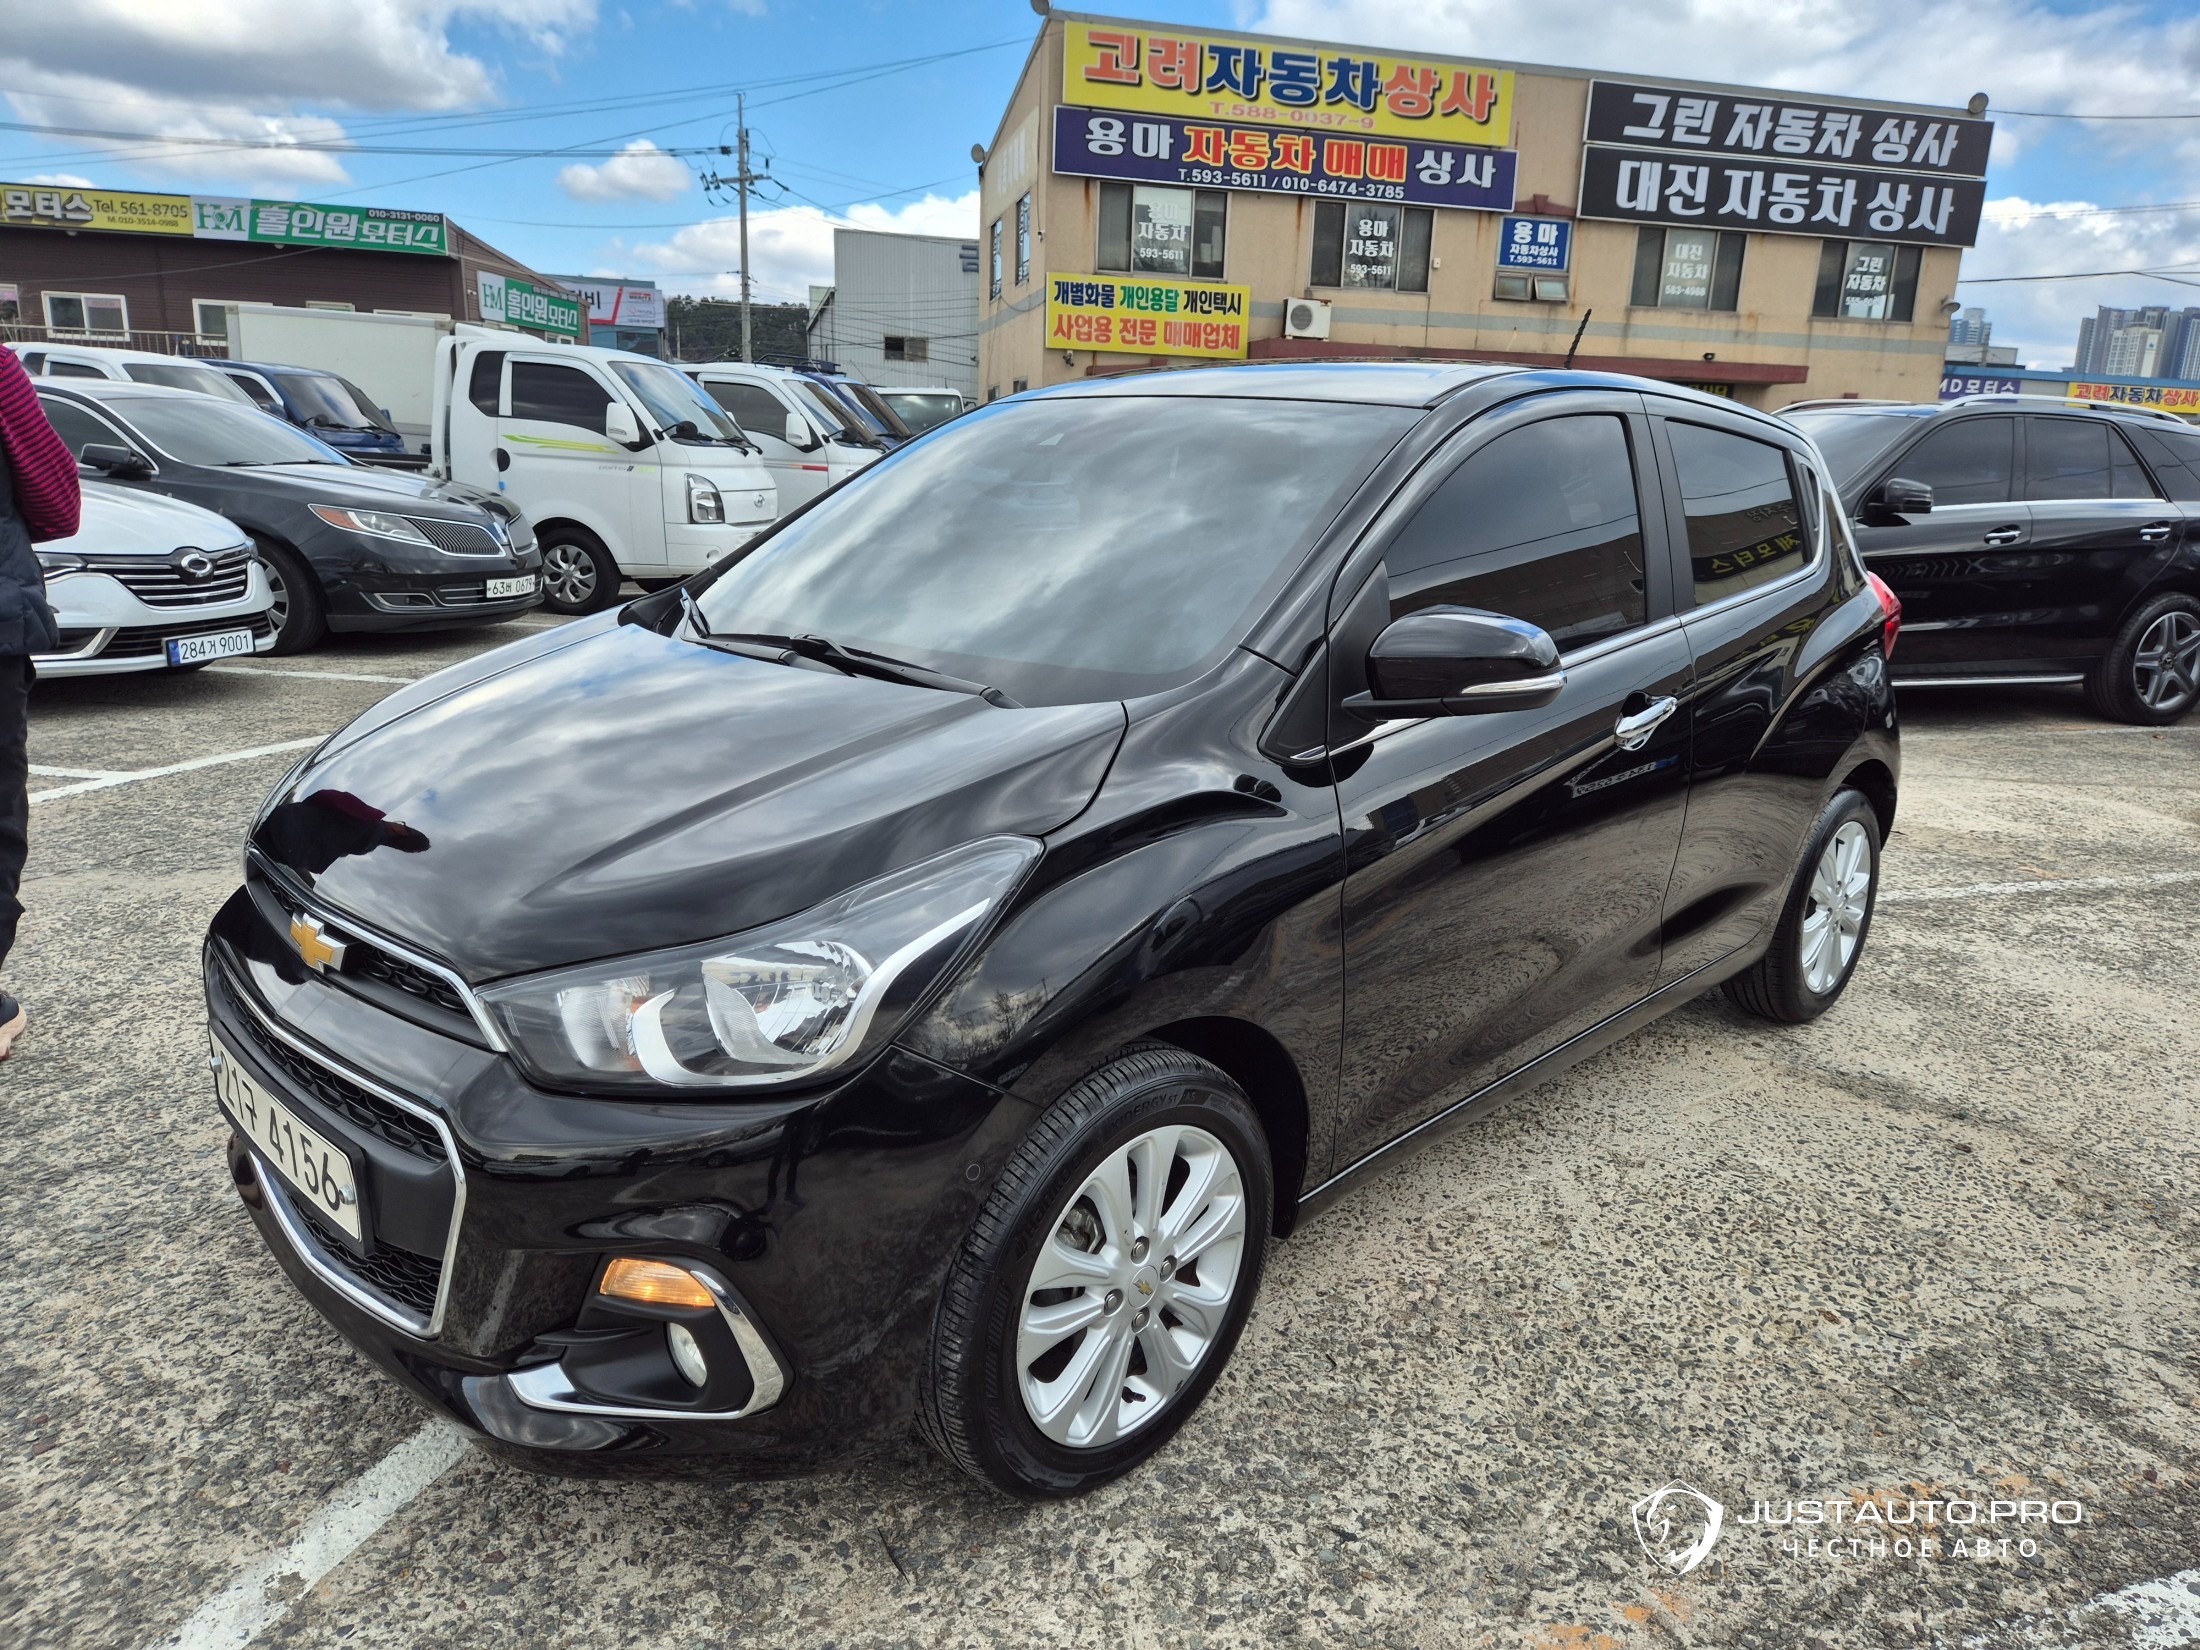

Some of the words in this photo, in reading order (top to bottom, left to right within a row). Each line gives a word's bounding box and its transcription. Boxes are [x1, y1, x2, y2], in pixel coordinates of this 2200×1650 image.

[1623, 93, 1720, 144] 그린
[1724, 103, 1863, 158] 자동차
[1871, 118, 1960, 167] 상사
[1085, 117, 1174, 160] 용마
[1182, 125, 1316, 174] 자동차
[1323, 139, 1408, 183] 매매
[1415, 150, 1496, 188] 상사
[1282, 175, 1405, 200] 010-6474-3785
[1615, 159, 1710, 216] 대진
[1717, 169, 1858, 227] 자동차
[1866, 182, 1954, 235] 상사
[4, 189, 94, 222] 모터스
[93, 199, 118, 214] Tel.
[120, 201, 188, 218] 561-8705
[1138, 221, 1186, 242] 자동차
[1358, 219, 1389, 238] 용마
[1139, 247, 1184, 261] 593-5611
[1349, 239, 1394, 258] 자동차
[1510, 243, 1559, 257] 자동차상사
[1674, 243, 1703, 261] 대진
[1350, 264, 1391, 276] 593-5611
[1666, 262, 1709, 280] 자동차
[1856, 256, 1884, 273] 그린
[1846, 273, 1887, 292] 자동차
[1054, 281, 1115, 309] 개별화물
[1120, 285, 1180, 313] 개인용달
[1183, 290, 1242, 316] 개인택시
[1053, 314, 1112, 344] 사업용
[1119, 318, 1157, 346] 전문
[1163, 320, 1241, 350] 매매업체
[515, 577, 532, 593] 0679
[219, 633, 249, 654] 9001
[269, 1105, 340, 1212] 4156
